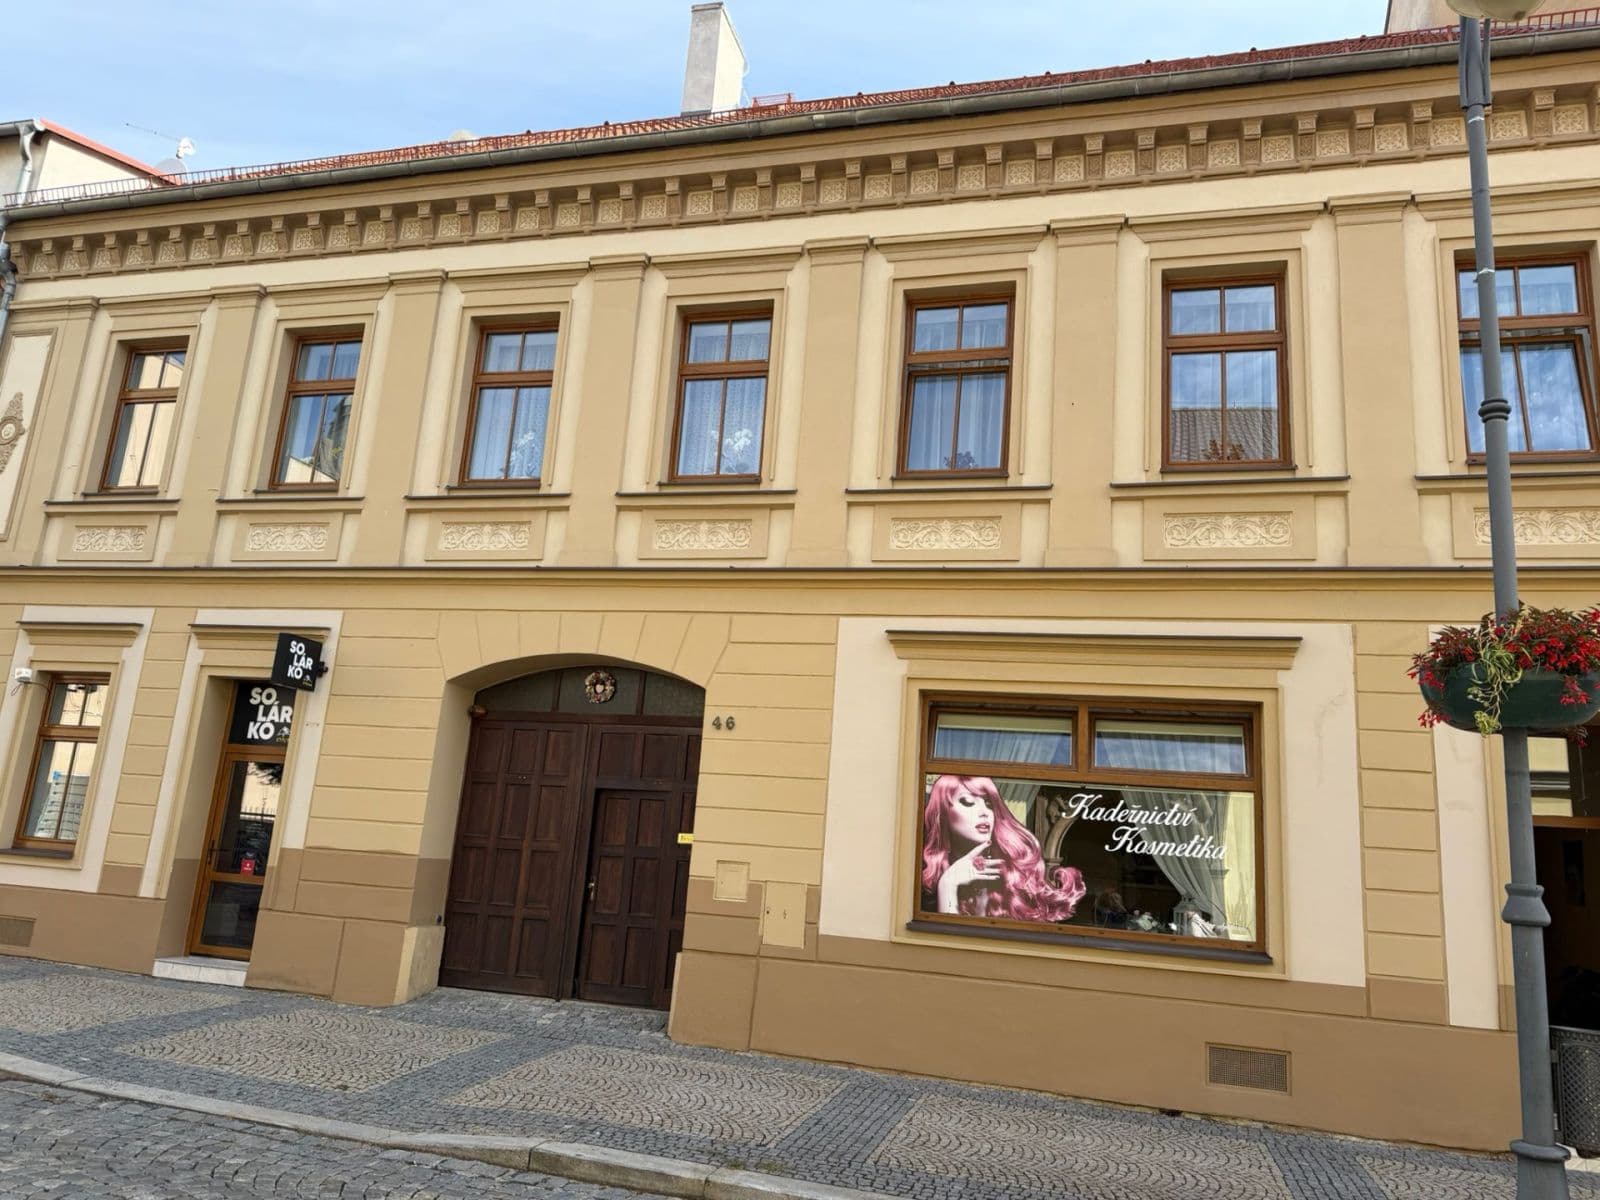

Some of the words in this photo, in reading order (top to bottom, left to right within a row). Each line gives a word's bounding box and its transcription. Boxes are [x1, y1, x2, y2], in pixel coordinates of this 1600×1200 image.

[290, 640, 305, 655] SO
[293, 653, 313, 670] LÁR
[287, 664, 303, 679] KO
[249, 687, 277, 705] SO
[256, 701, 293, 723] LÁR
[246, 721, 275, 740] KO
[712, 716, 735, 730] 46
[1061, 793, 1197, 827] Kadeřnictví
[1104, 826, 1227, 860] Kosmetika
